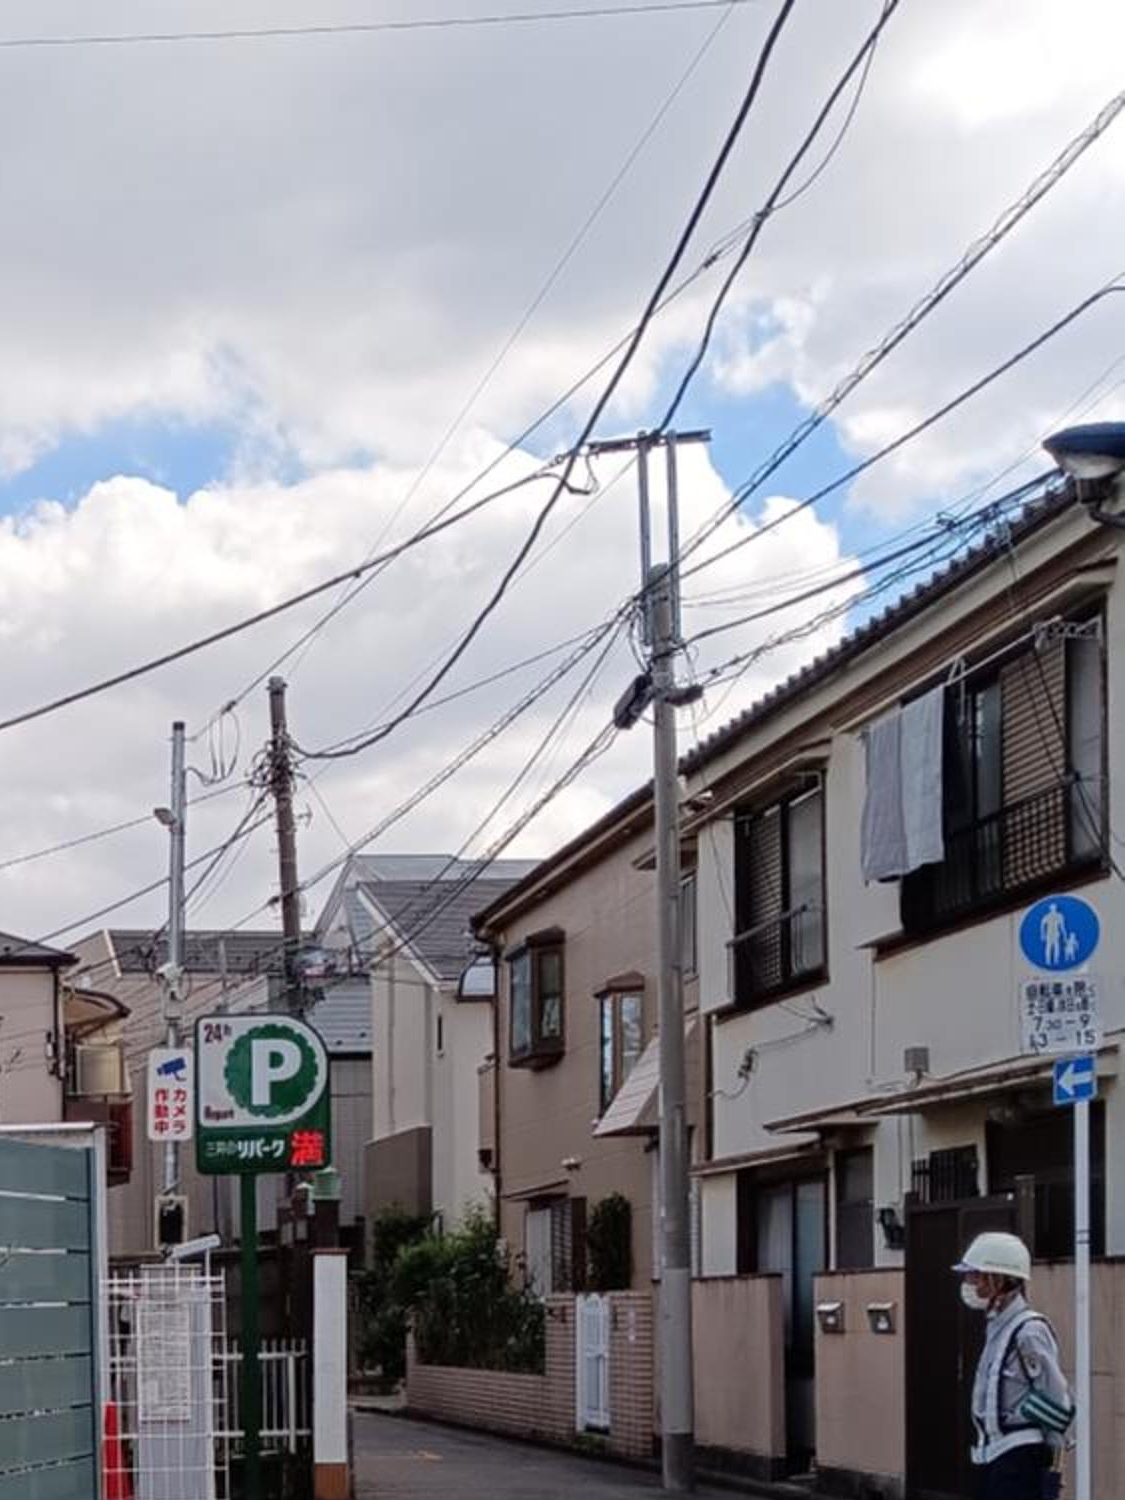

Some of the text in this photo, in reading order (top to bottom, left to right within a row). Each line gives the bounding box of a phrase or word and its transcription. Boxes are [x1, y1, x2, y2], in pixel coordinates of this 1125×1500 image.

[251, 1039, 302, 1106] P
[154, 1088, 169, 1134] 作動中
[173, 1088, 187, 1134] カメラ
[291, 1132, 323, 1165] 満
